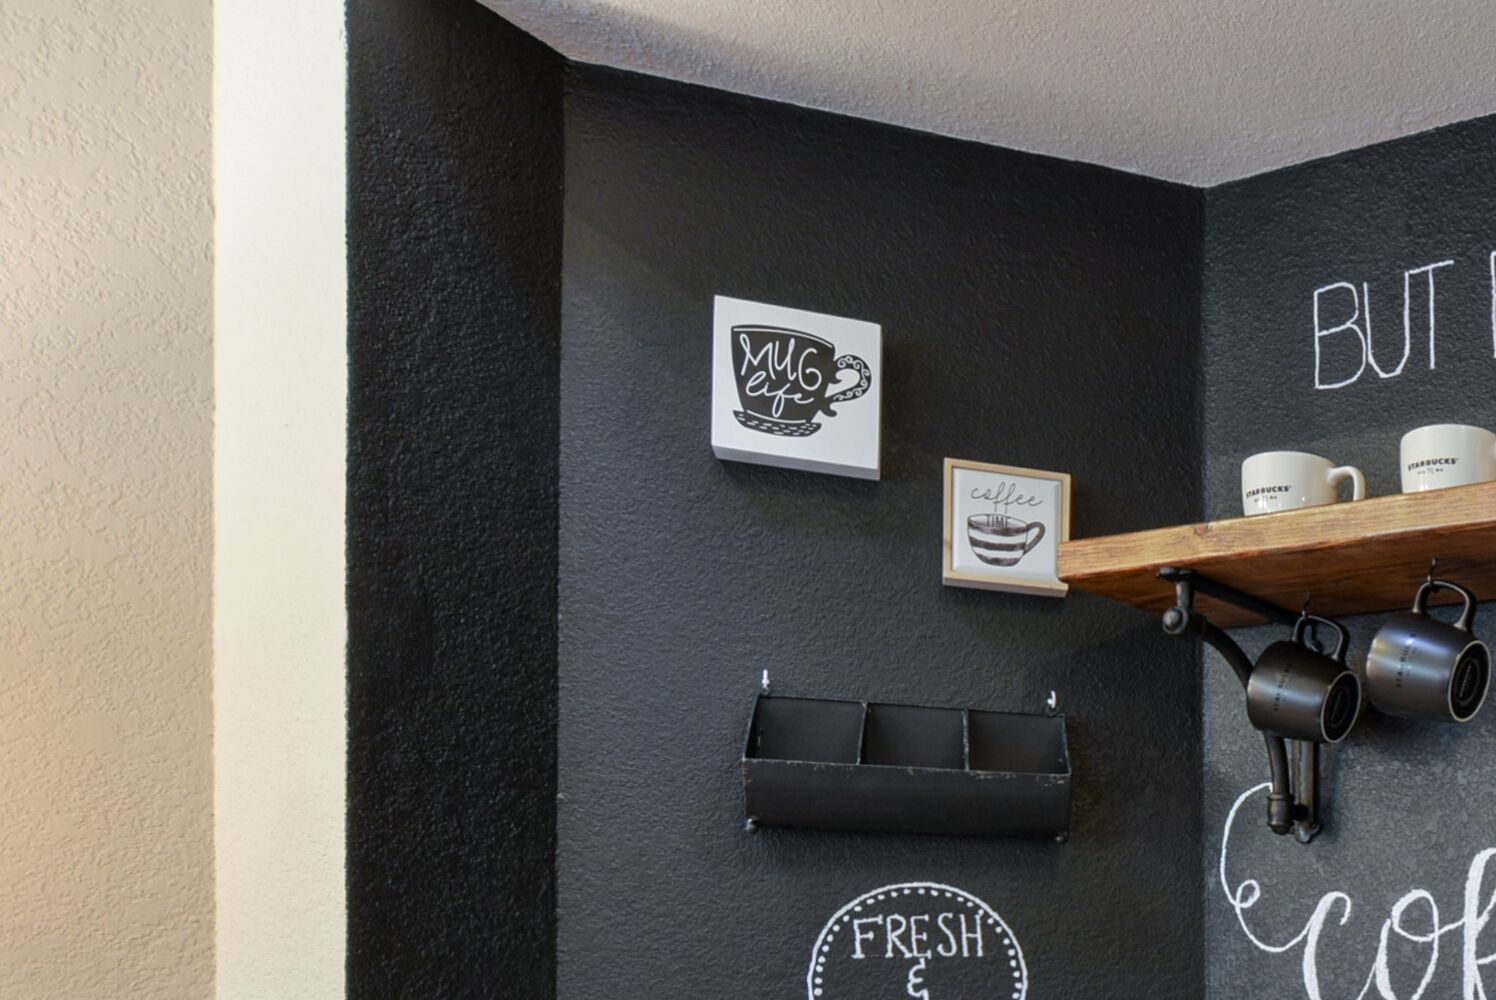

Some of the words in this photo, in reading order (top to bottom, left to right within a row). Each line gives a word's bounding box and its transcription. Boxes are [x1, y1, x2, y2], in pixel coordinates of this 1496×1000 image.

[1313, 259, 1455, 390] BUT
[739, 333, 822, 391] MUG
[745, 370, 815, 418] life
[970, 481, 1043, 507] coffee
[851, 911, 984, 960] FRESH
